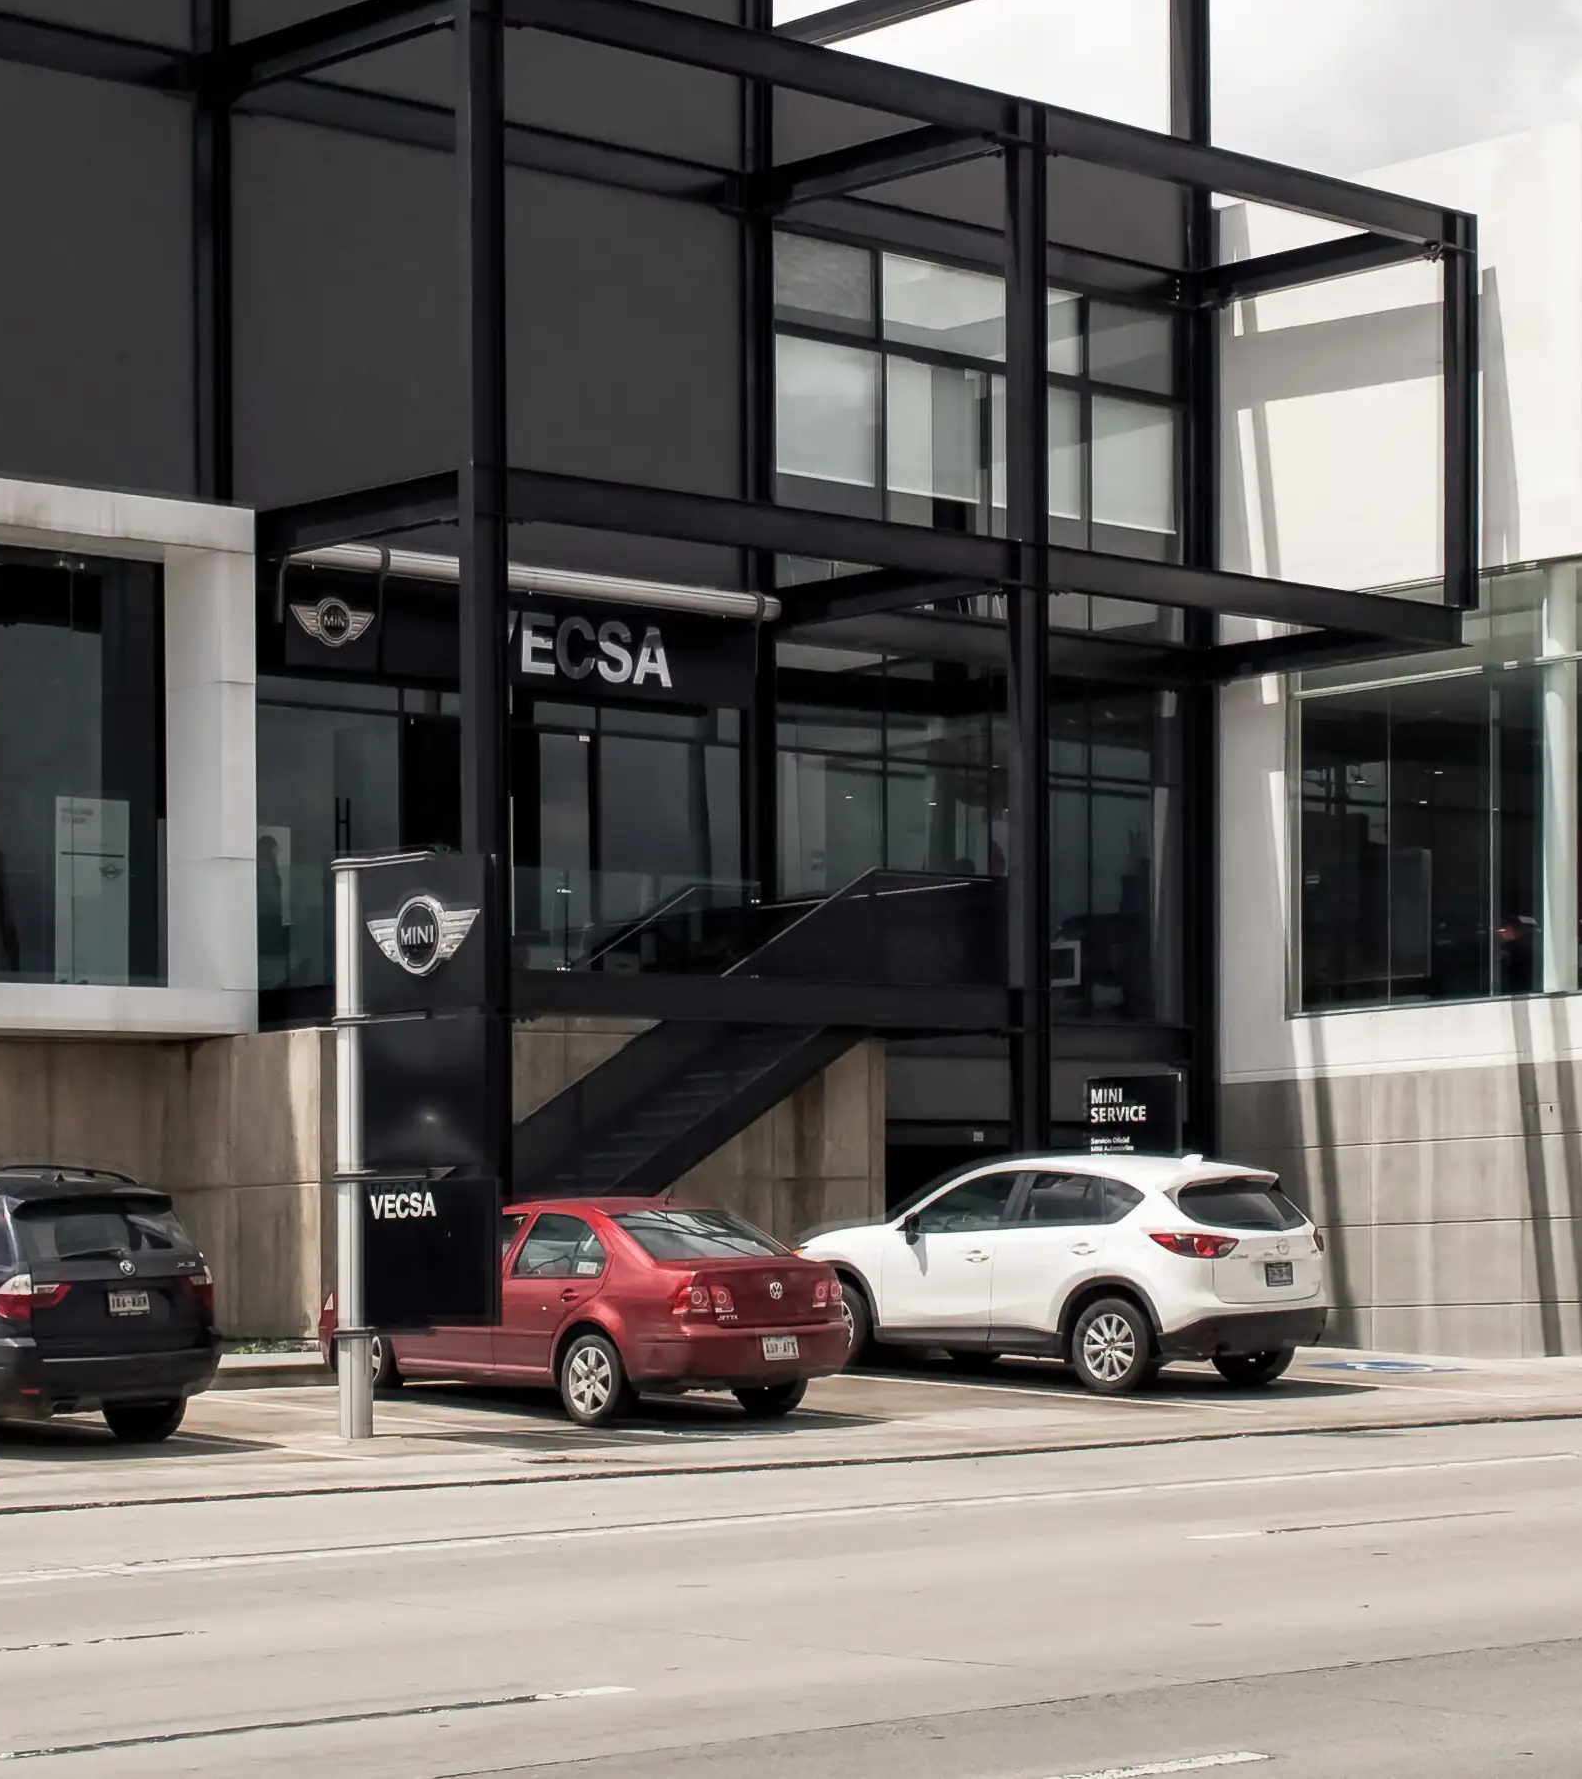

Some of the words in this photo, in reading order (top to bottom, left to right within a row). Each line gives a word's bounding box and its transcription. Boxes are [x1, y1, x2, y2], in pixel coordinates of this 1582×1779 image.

[401, 925, 434, 945] MINI
[1091, 1088, 1123, 1104] MINI
[1090, 1106, 1147, 1123] SERVICE
[370, 1191, 437, 1219] VECSA
